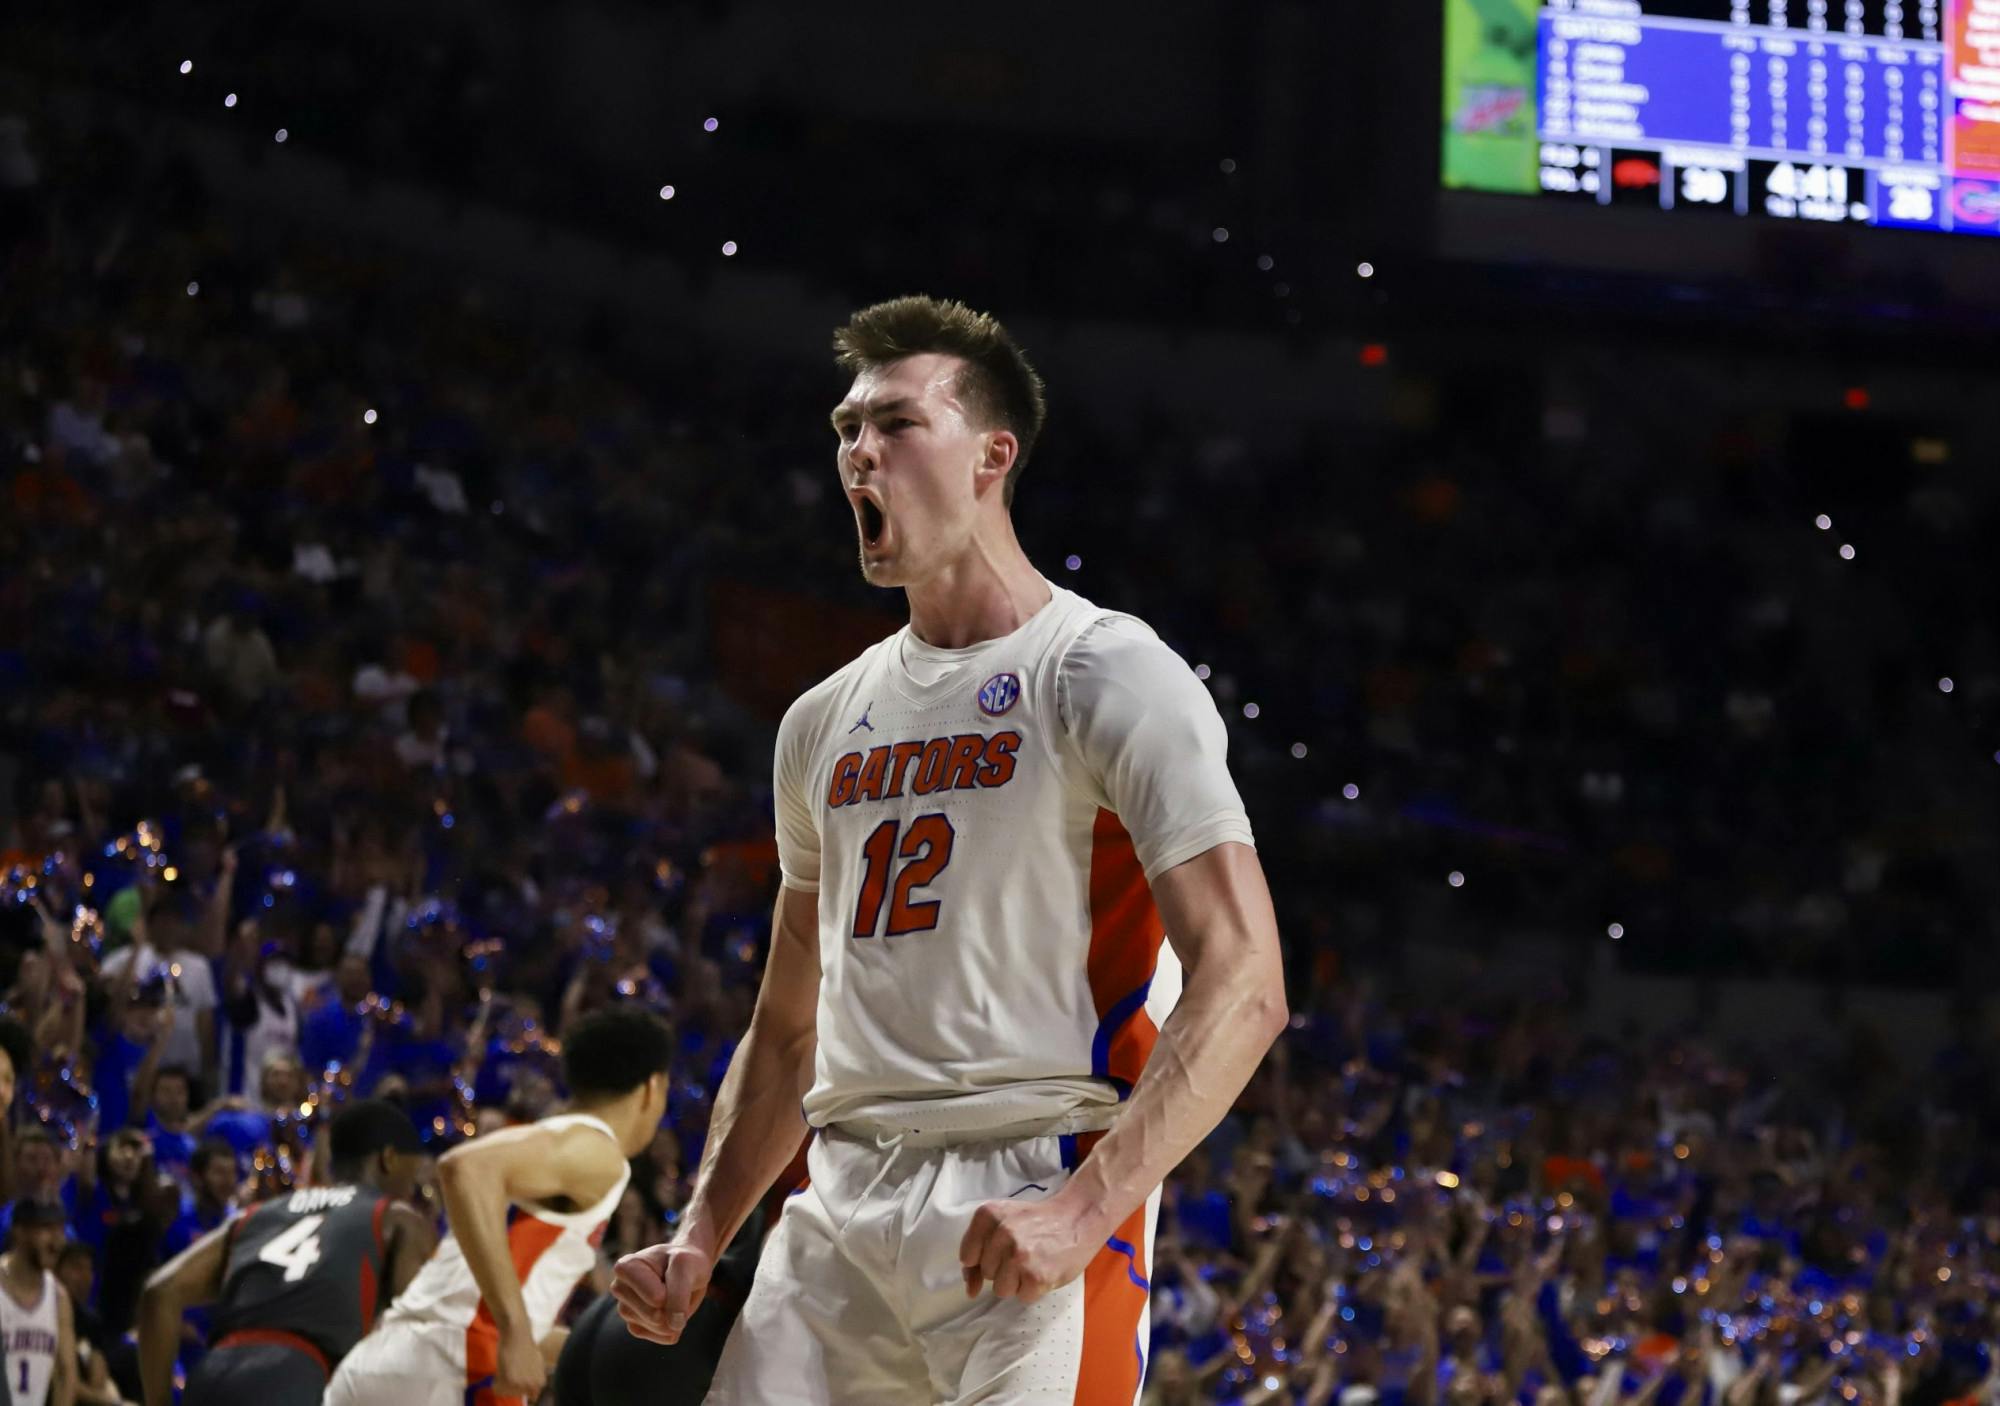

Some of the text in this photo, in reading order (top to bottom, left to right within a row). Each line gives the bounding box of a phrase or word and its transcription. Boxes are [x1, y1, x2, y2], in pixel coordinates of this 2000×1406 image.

[981, 673, 1019, 712] SEC
[828, 731, 1022, 809] GATORS
[853, 812, 955, 938] 12
[258, 1214, 322, 1283] 4
[18, 1359, 30, 1394] 1
